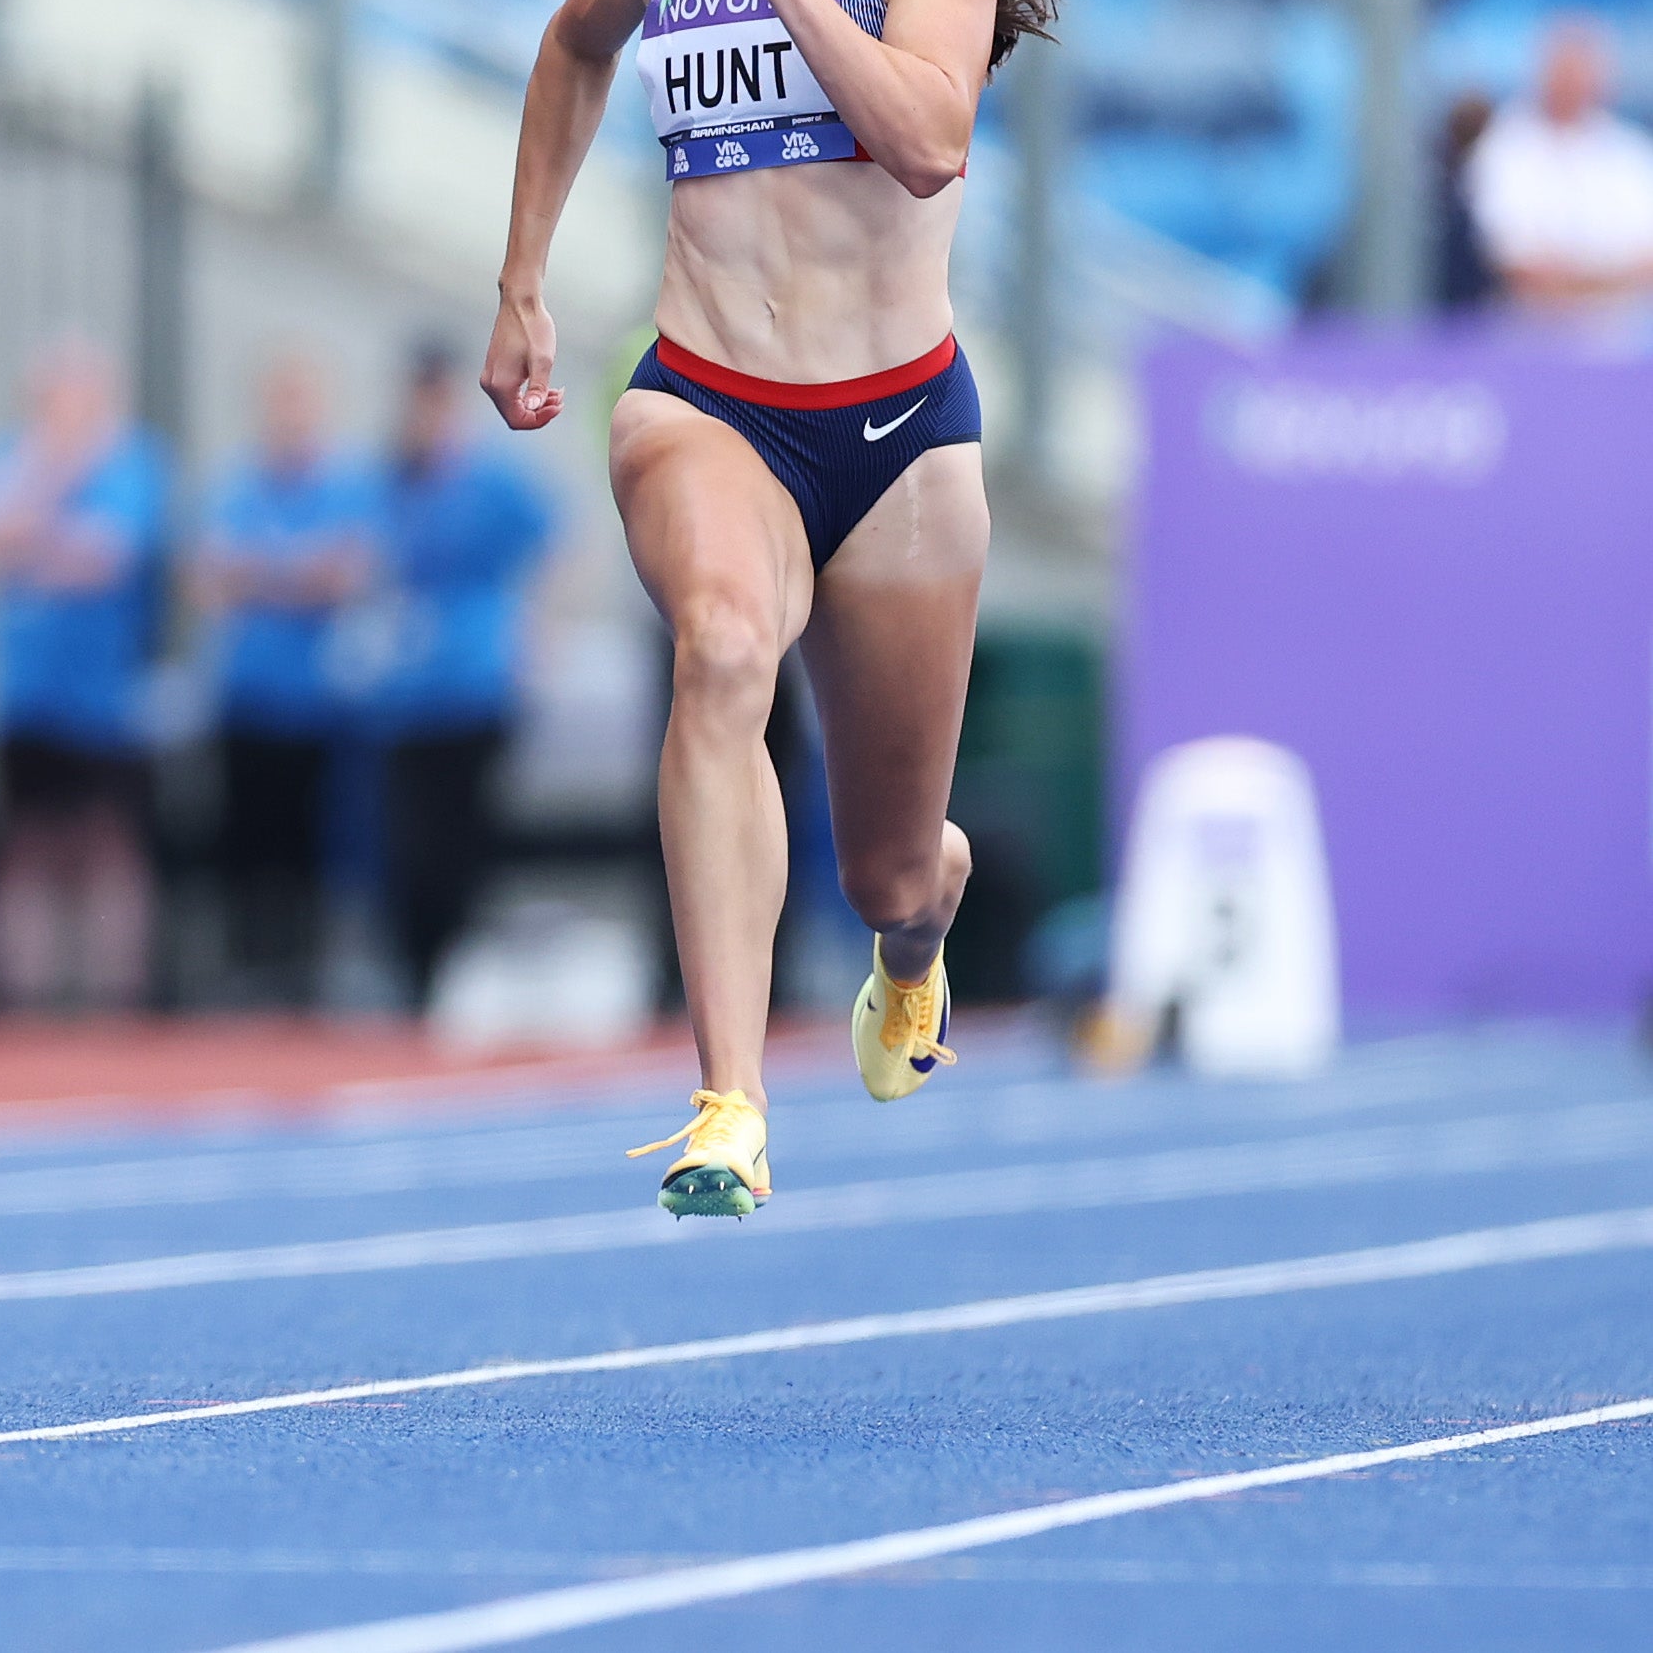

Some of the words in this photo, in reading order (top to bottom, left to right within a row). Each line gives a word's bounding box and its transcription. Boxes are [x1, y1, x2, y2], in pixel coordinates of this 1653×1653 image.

[665, 40, 792, 114] HUNT
[690, 120, 775, 139] BIRMINGHAM
[782, 131, 814, 148] VITA
[715, 140, 745, 156] VITA
[781, 145, 820, 160] COCO
[715, 154, 750, 168] COCO
